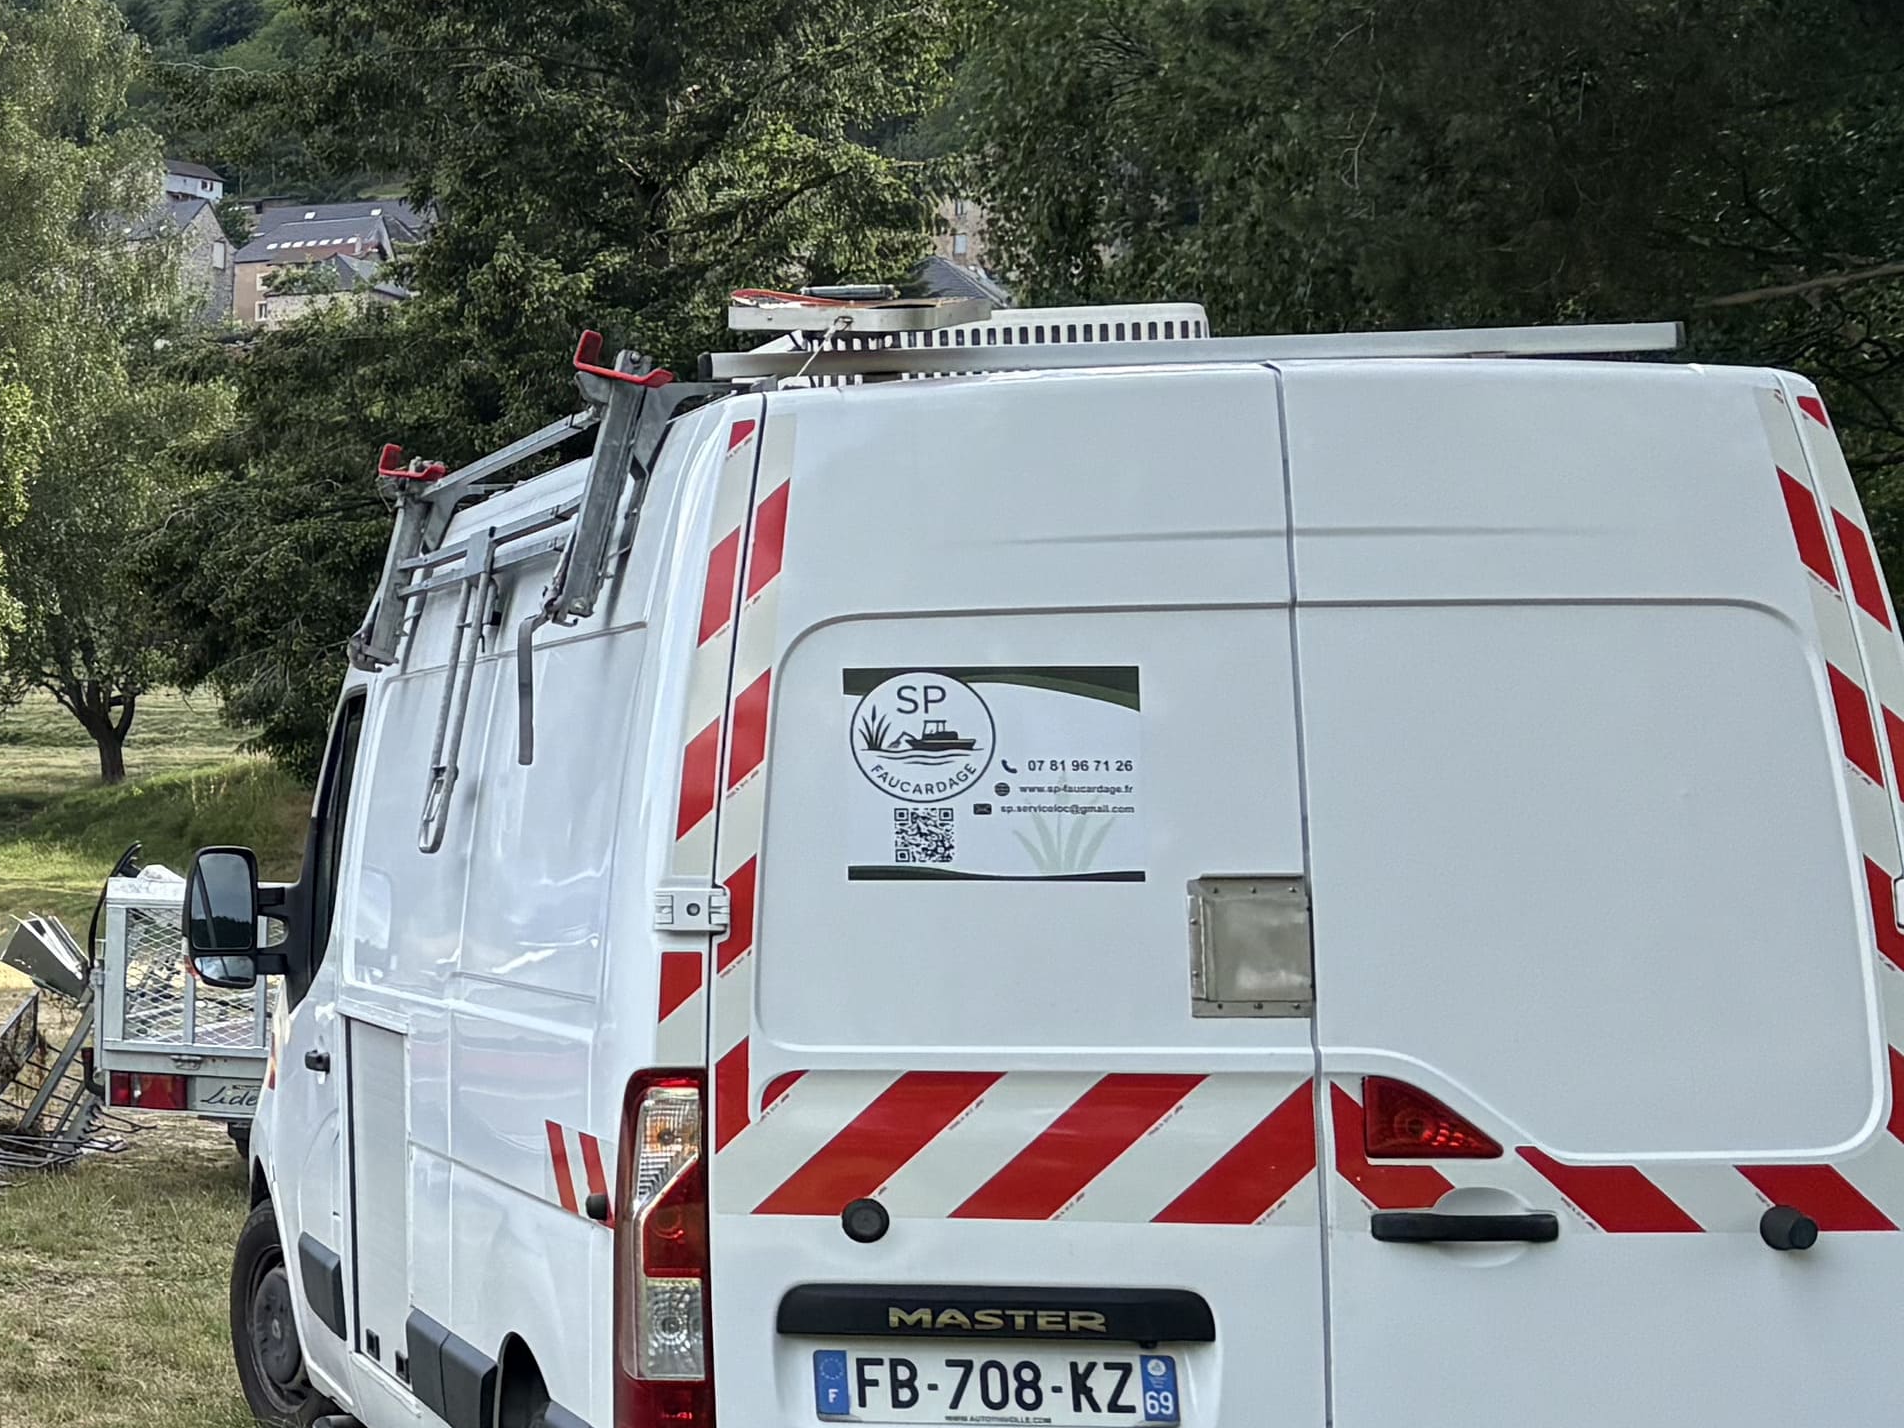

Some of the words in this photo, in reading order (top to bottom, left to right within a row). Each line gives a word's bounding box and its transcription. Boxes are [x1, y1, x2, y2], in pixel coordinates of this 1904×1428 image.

[895, 685, 947, 714] SP
[870, 763, 977, 795] FAUCARDAGE
[1028, 760, 1045, 772] 07
[1049, 760, 1066, 772] 81
[1071, 760, 1090, 772] 96
[1093, 760, 1110, 772] 71
[1115, 760, 1134, 772] 26
[1019, 784, 1134, 795] www.sp-faucardage.fr
[888, 1307, 1107, 1332] MASTER
[828, 1388, 839, 1403] F
[855, 1357, 1137, 1414] FB-708-KZ
[1145, 1391, 1175, 1415] 69
